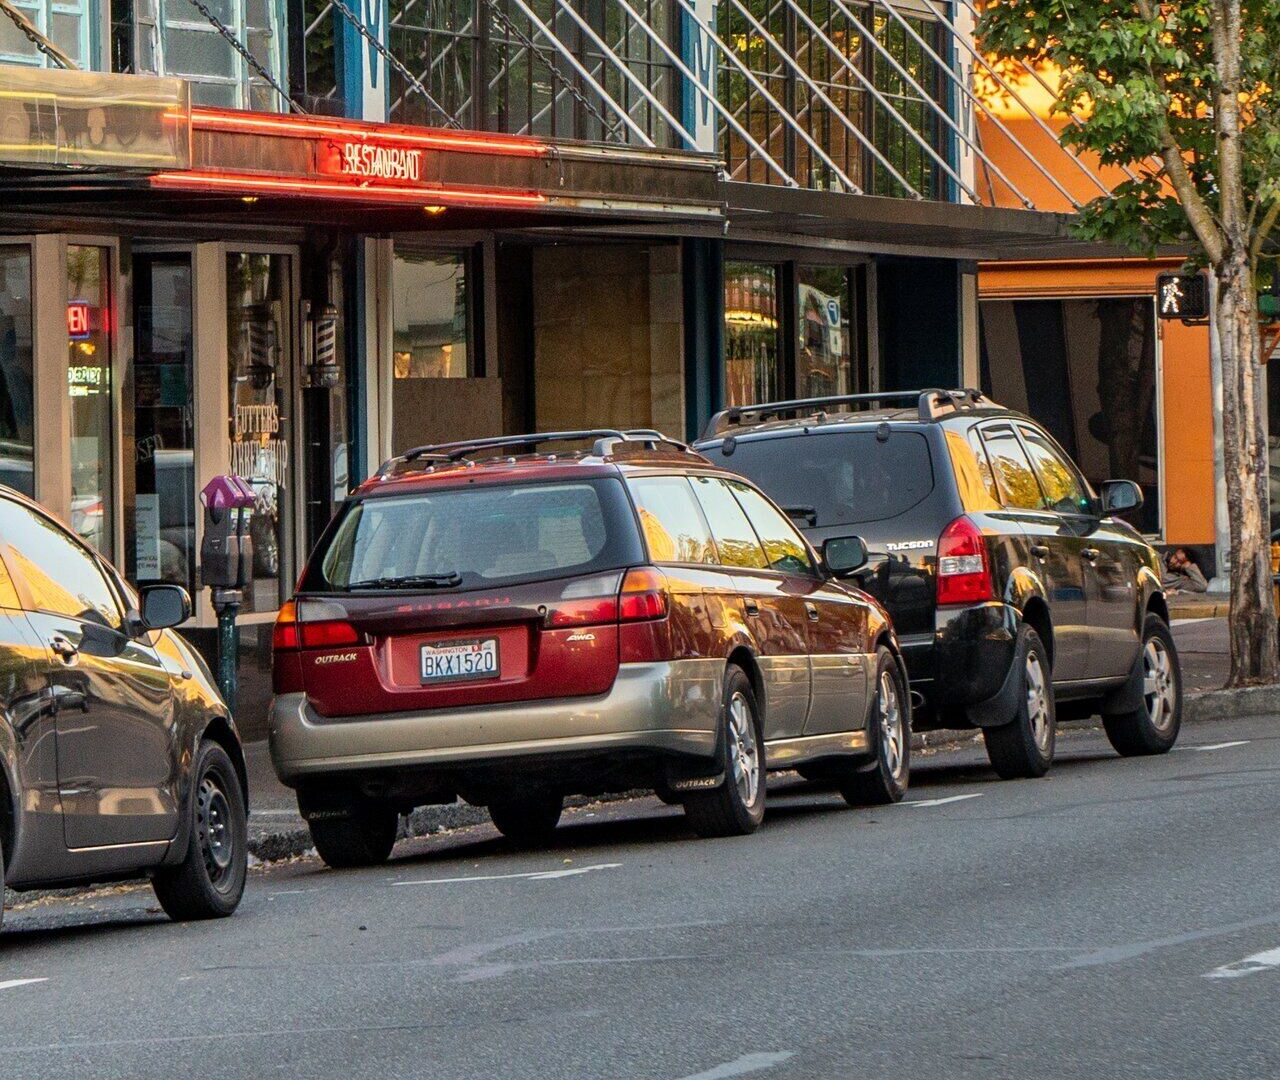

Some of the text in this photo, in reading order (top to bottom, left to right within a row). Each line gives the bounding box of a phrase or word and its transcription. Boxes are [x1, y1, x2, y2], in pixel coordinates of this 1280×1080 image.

[342, 142, 422, 181] RESTAURANT
[67, 306, 88, 332] EN
[886, 540, 934, 551] TUCSON
[397, 598, 511, 613] SUBARU
[566, 633, 596, 641] AWD
[425, 645, 469, 655] WASHINGTON
[315, 653, 358, 664] OUTBACK
[425, 651, 494, 676] BKX1520
[676, 777, 716, 788] OUTBACK
